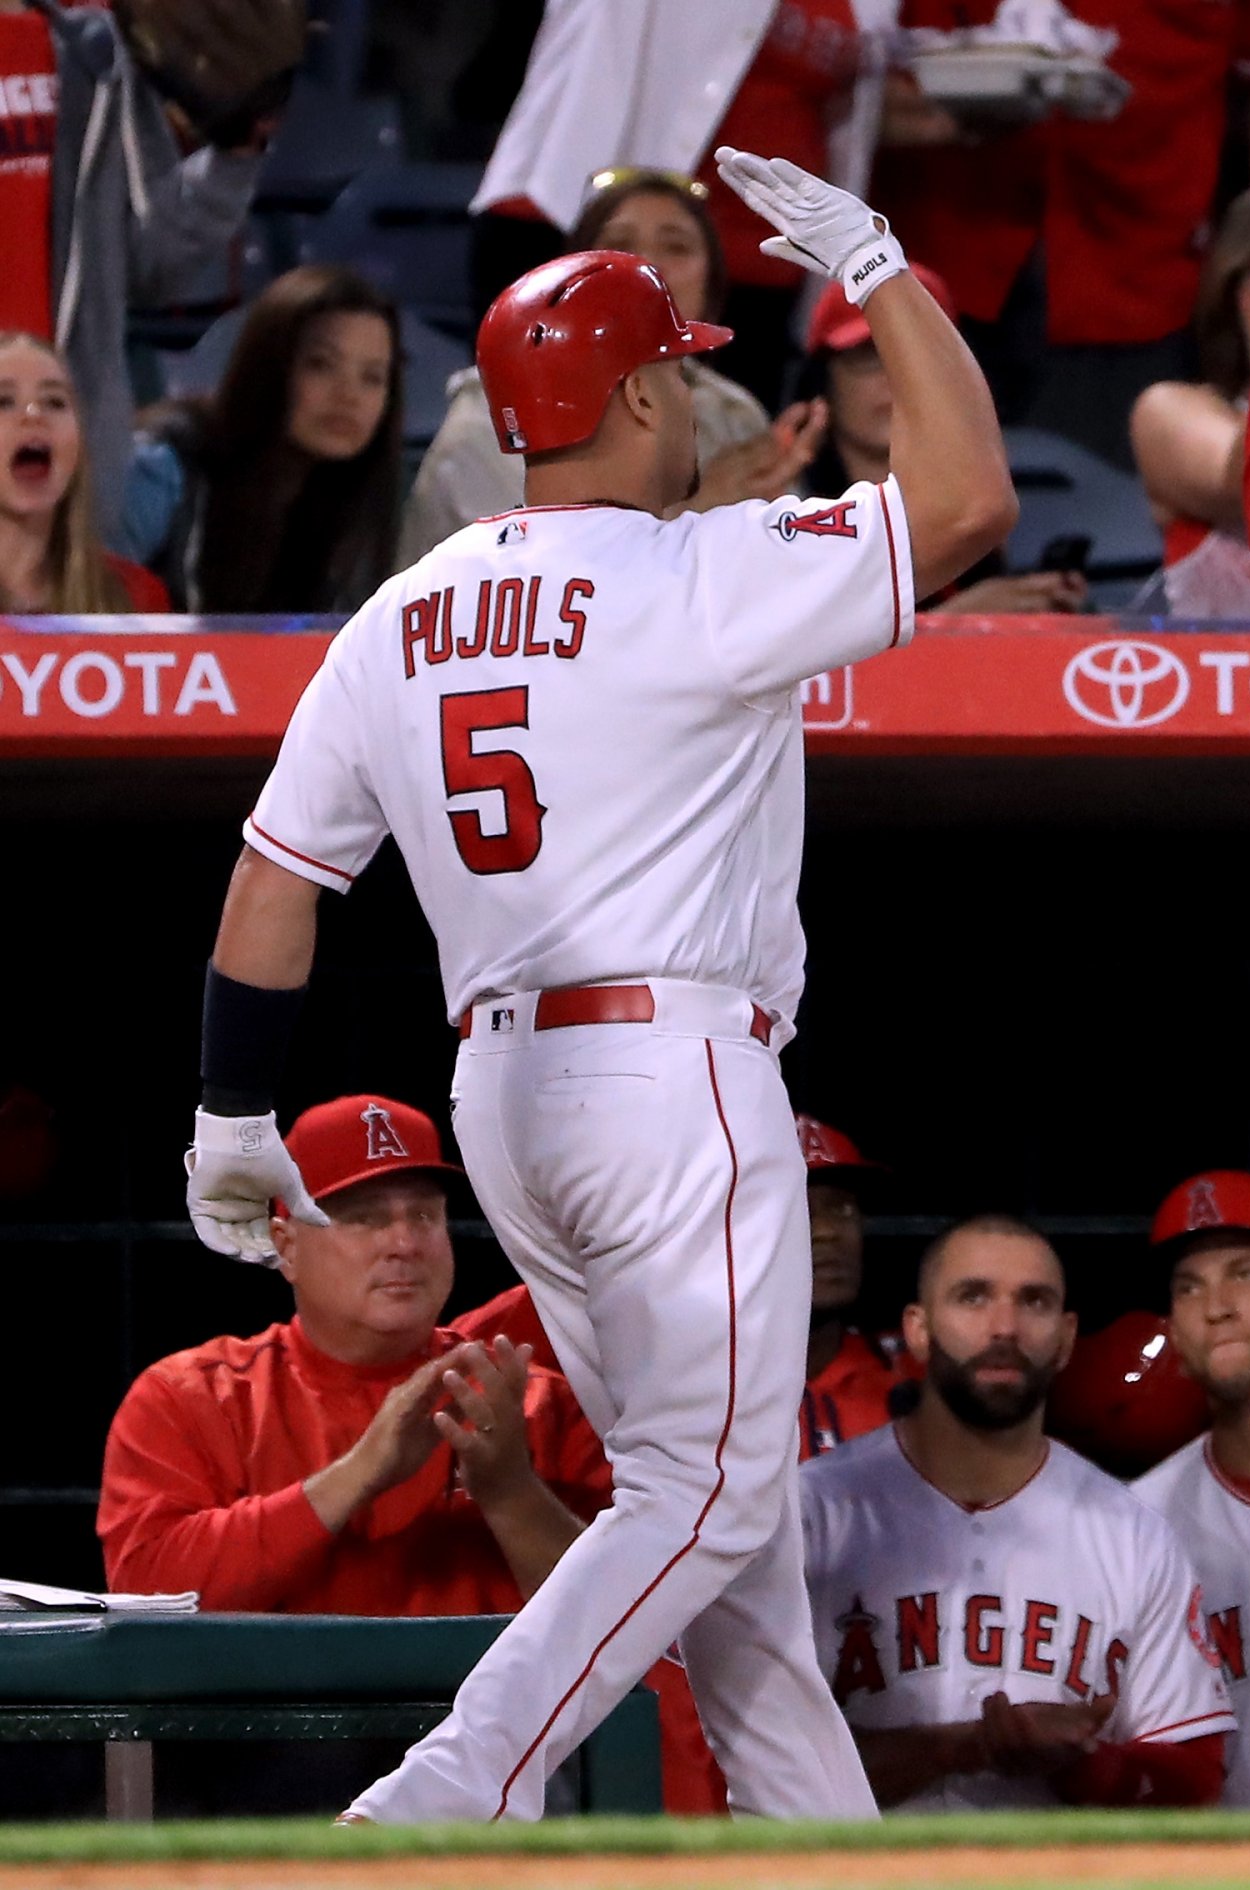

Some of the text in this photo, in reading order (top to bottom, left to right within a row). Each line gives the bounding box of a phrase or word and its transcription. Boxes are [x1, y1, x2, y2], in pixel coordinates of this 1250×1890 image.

[851, 252, 888, 286] PUJOLS
[402, 576, 595, 679] PUJOLS
[0, 650, 238, 719] YOTA
[440, 685, 549, 875] 5
[360, 1103, 409, 1161] A
